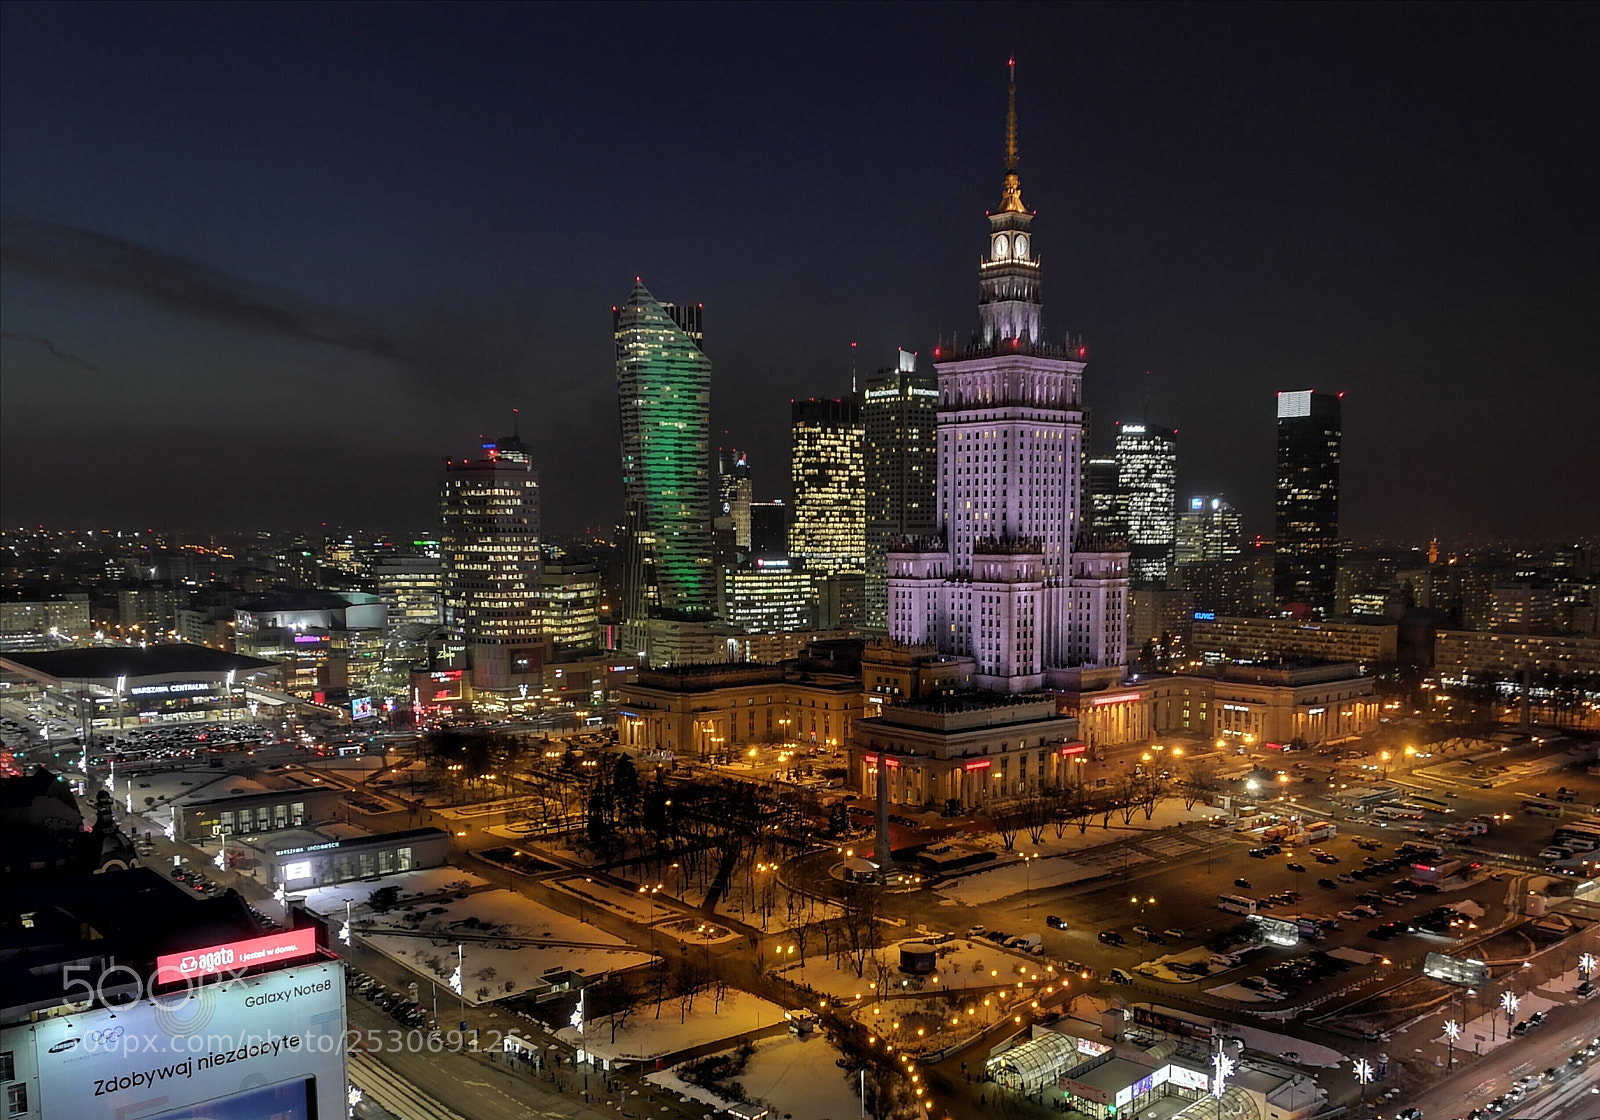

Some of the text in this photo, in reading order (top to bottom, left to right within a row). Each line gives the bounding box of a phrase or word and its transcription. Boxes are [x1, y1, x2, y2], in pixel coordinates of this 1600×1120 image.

[131, 683, 209, 695] WARSZAWA CENTRALNA
[198, 947, 235, 972] agata
[244, 979, 332, 1009] Galaxy Note8
[93, 1034, 301, 1097] Zdobywaj niezdobyte
